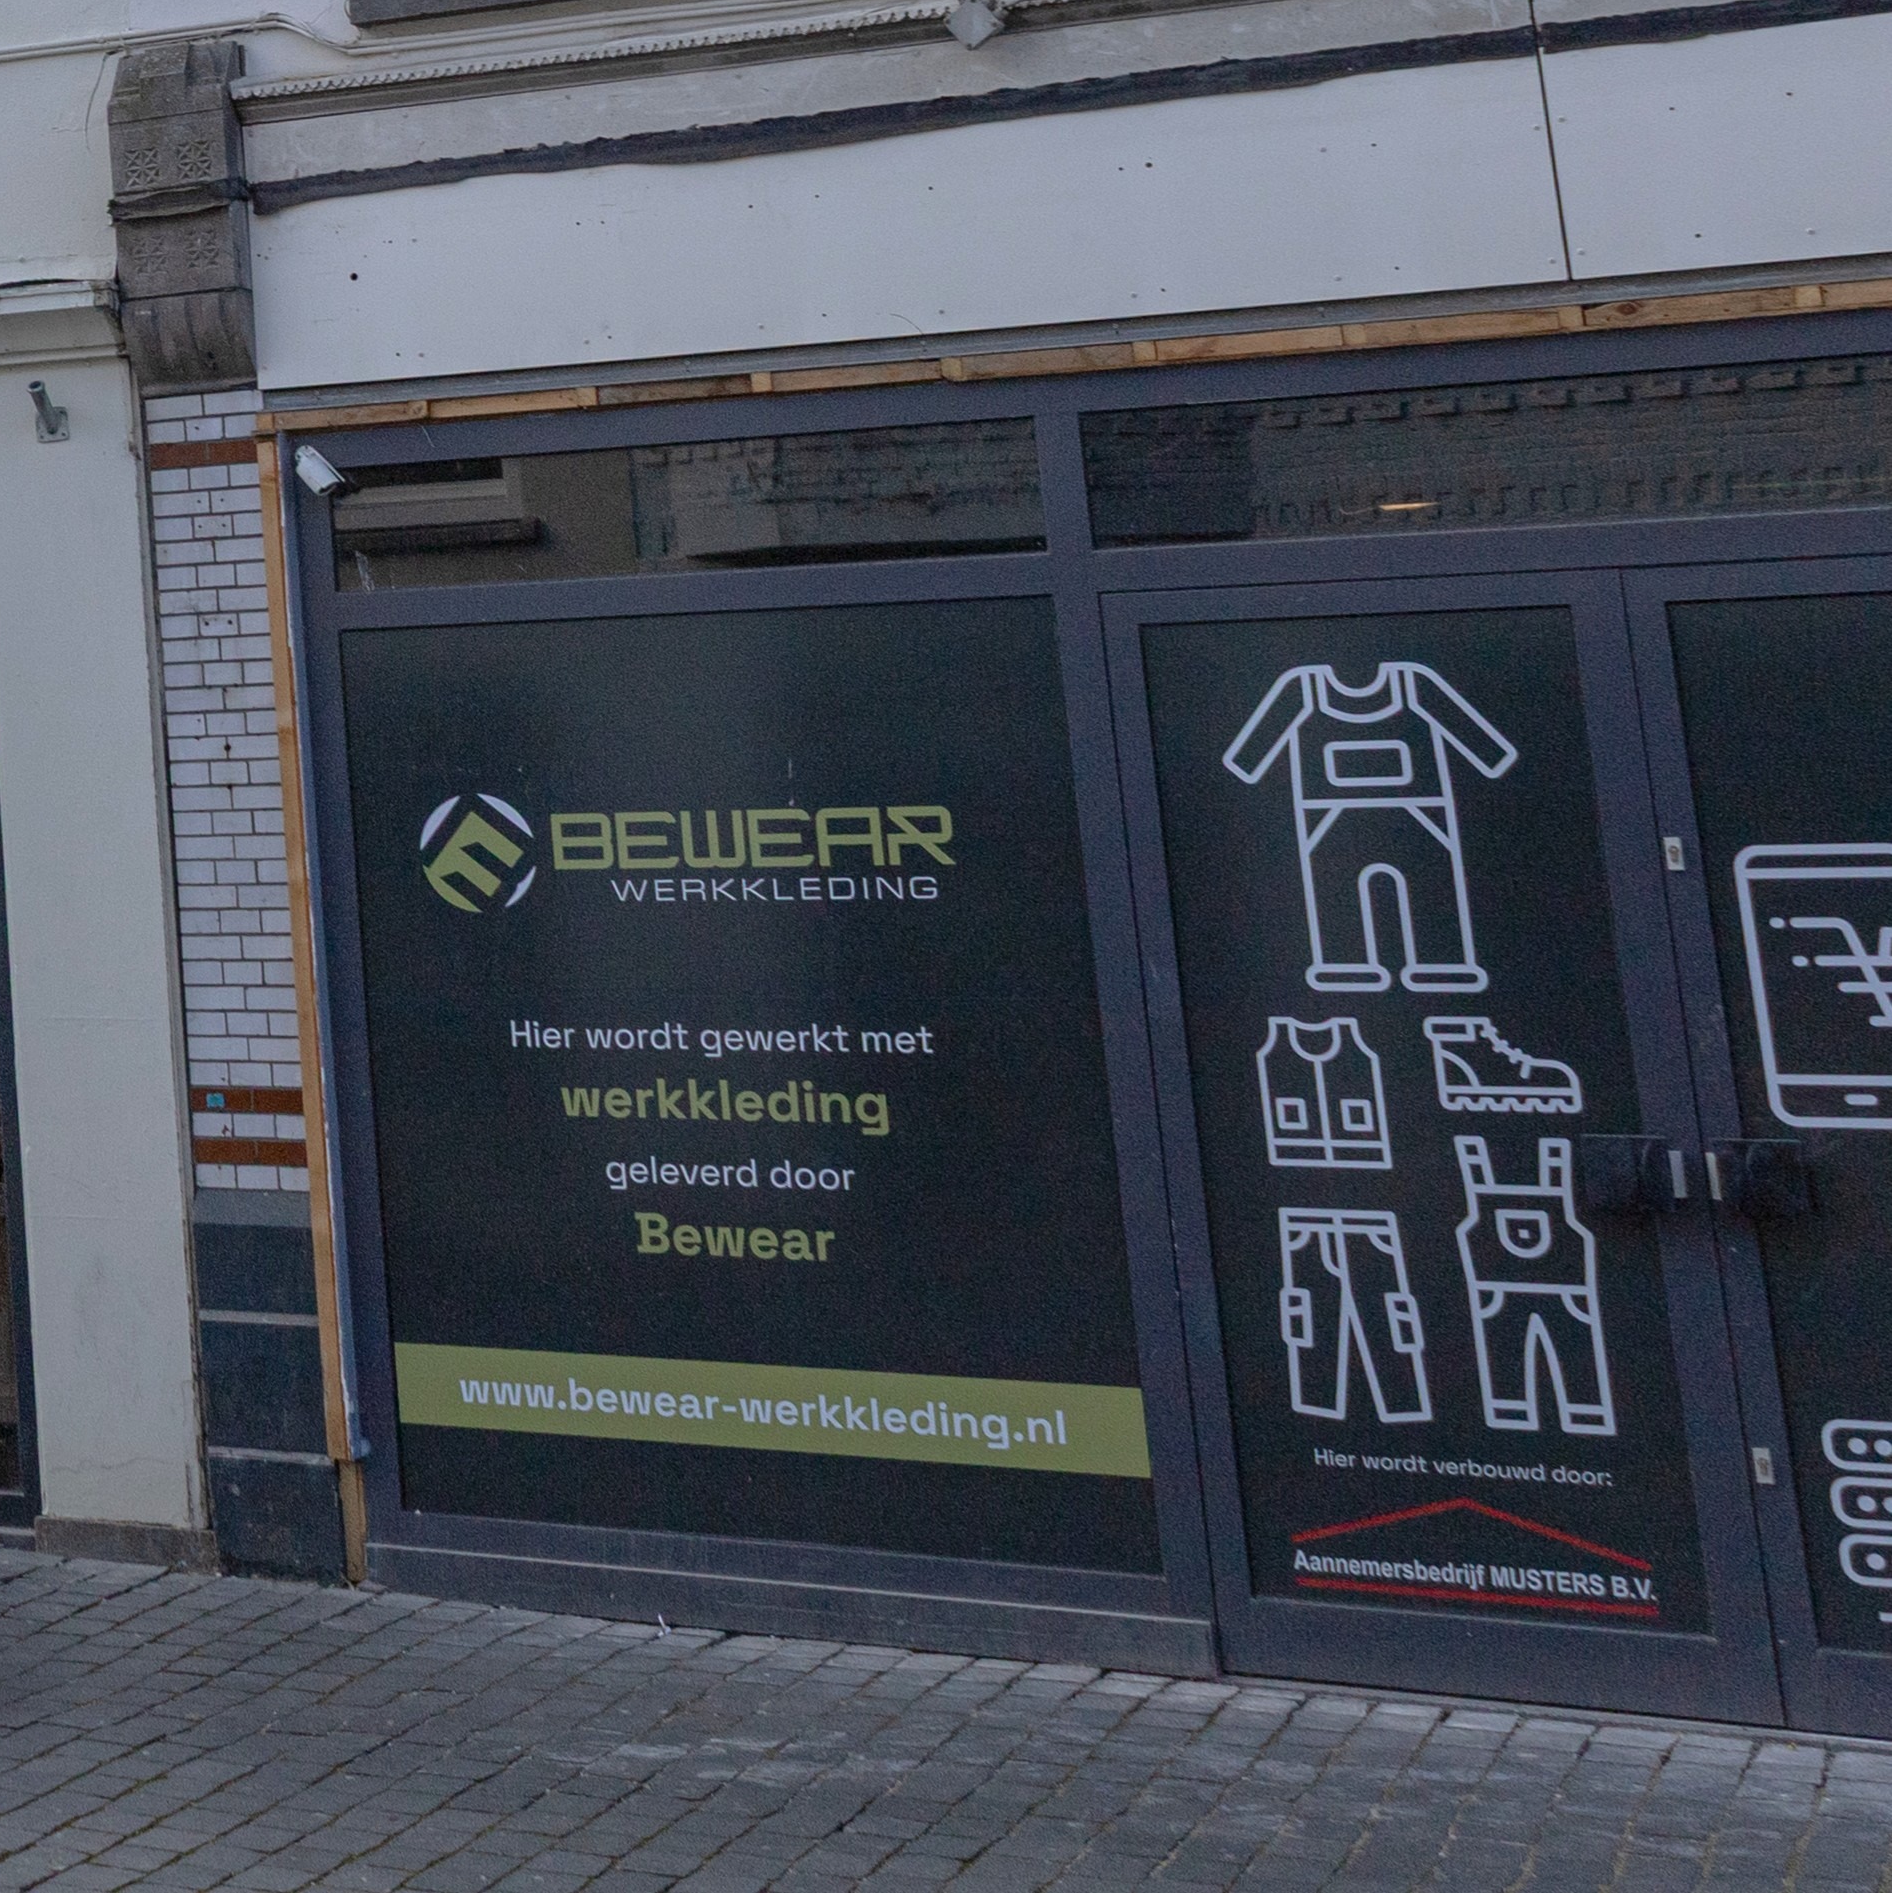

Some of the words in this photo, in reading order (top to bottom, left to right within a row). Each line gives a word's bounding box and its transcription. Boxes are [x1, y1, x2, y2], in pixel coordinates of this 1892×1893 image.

[550, 805, 957, 870] BEWEAR
[611, 876, 940, 902] WERKKLEDING
[510, 1020, 575, 1049] Hier
[585, 1022, 689, 1051] wordt
[700, 1024, 850, 1057] gewerkt
[860, 1025, 934, 1054] met
[560, 1078, 890, 1136] werkkleding
[606, 1157, 758, 1190] geleverd
[770, 1160, 855, 1190] door
[634, 1211, 835, 1261] Bewear
[459, 1375, 1067, 1450] www.bewear-werkkleding.nl
[1314, 1448, 1357, 1469] Hier
[1362, 1454, 1428, 1474] wordt
[1433, 1459, 1545, 1484] verbouwd
[1551, 1465, 1613, 1487] door:
[1293, 1549, 1485, 1592] Aannemersbedrijf
[1490, 1564, 1605, 1598] MUSTERS
[1610, 1575, 1659, 1601] B.V.
